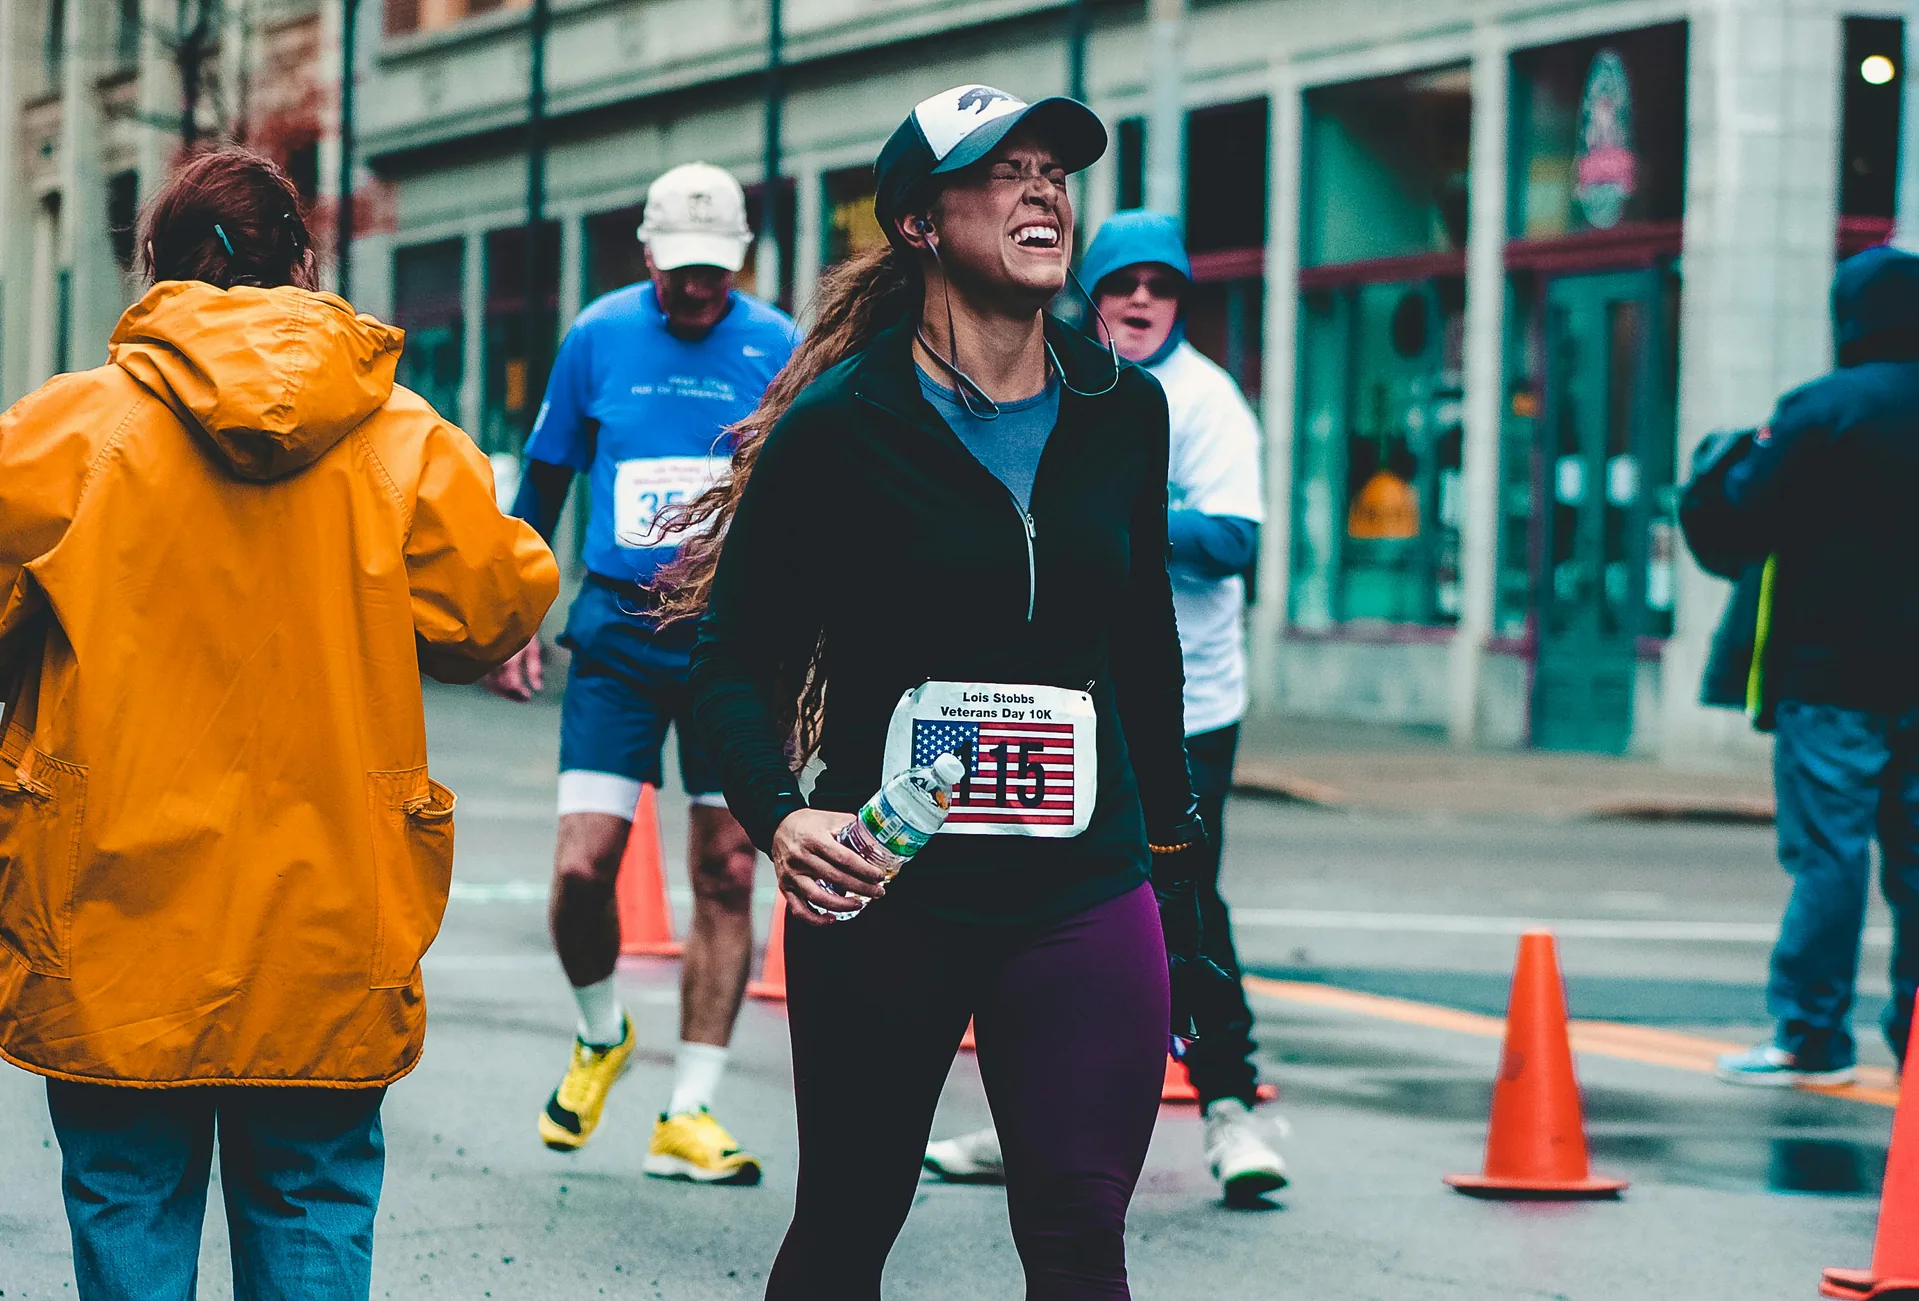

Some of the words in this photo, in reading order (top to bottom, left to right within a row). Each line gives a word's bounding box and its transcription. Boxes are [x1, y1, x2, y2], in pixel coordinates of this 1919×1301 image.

[962, 692, 990, 703] Lois
[993, 693, 1035, 705] Stobbs
[940, 706, 998, 718] Veterans
[1002, 708, 1025, 720] Day
[1029, 709, 1052, 720] 10K
[953, 741, 1045, 808] 115
